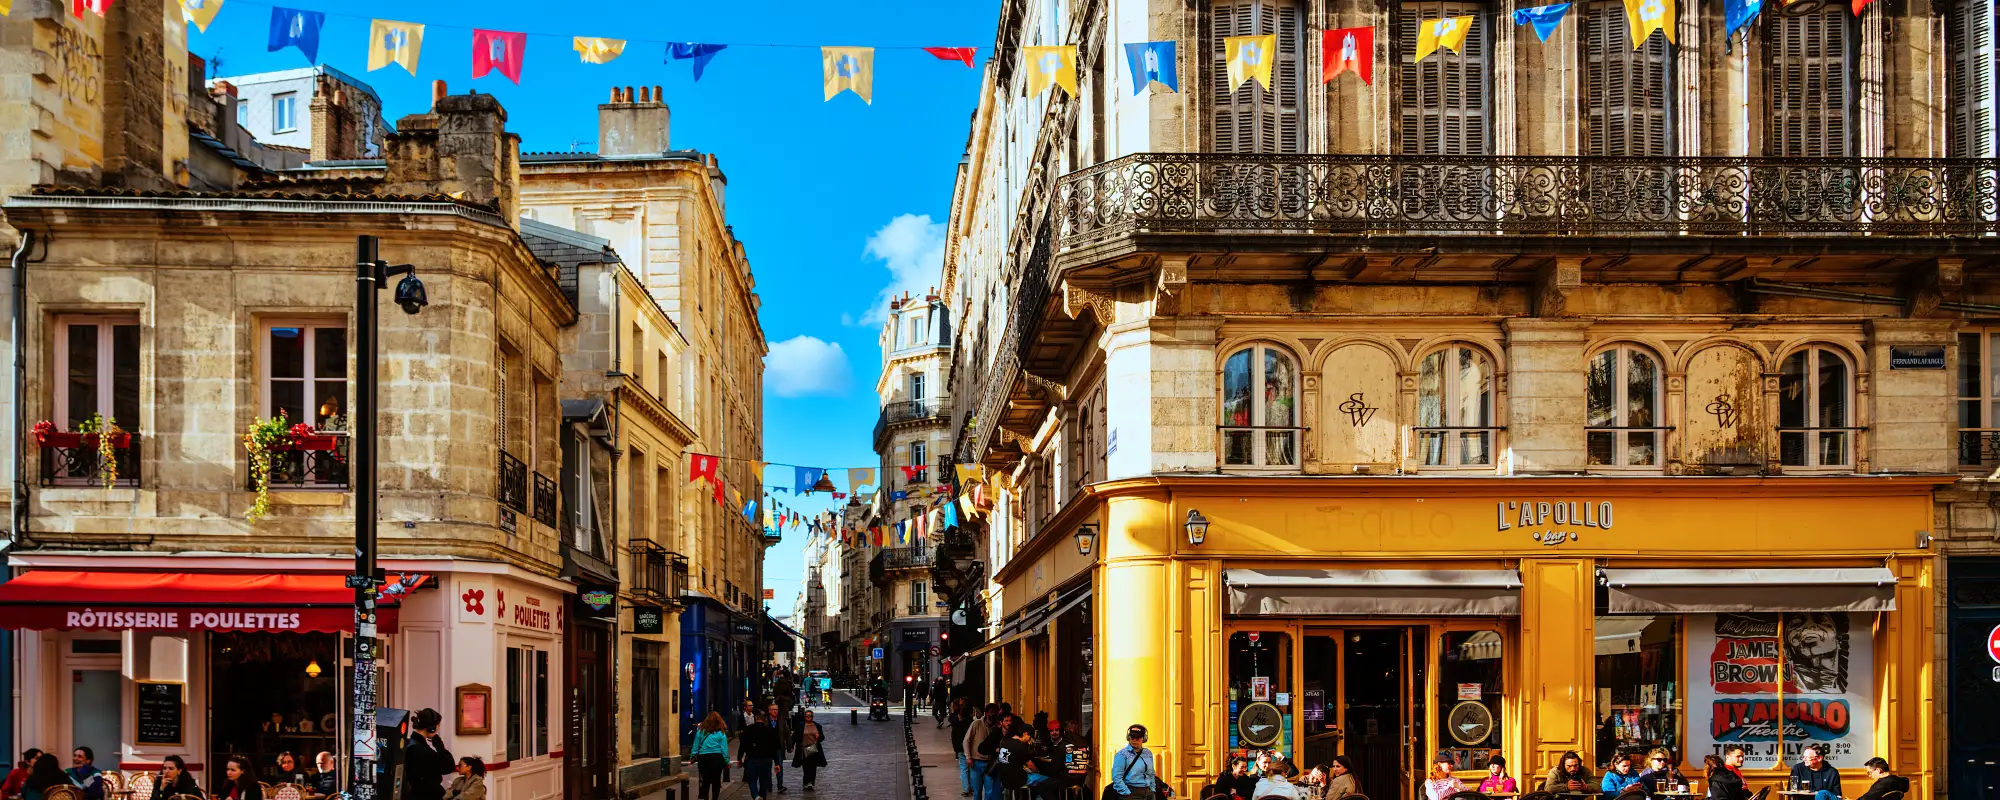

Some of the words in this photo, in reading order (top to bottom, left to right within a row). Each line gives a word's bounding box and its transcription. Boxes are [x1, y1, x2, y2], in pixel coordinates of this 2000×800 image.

[1497, 501, 1613, 532] L'APOLLO
[1543, 530, 1567, 545] bar
[66, 607, 179, 628] RÔTISSERIE
[189, 612, 300, 629] POULETTES
[514, 604, 550, 630] POULETTES
[1713, 702, 1750, 738] N.Y.
[1738, 720, 1810, 738] Theatre
